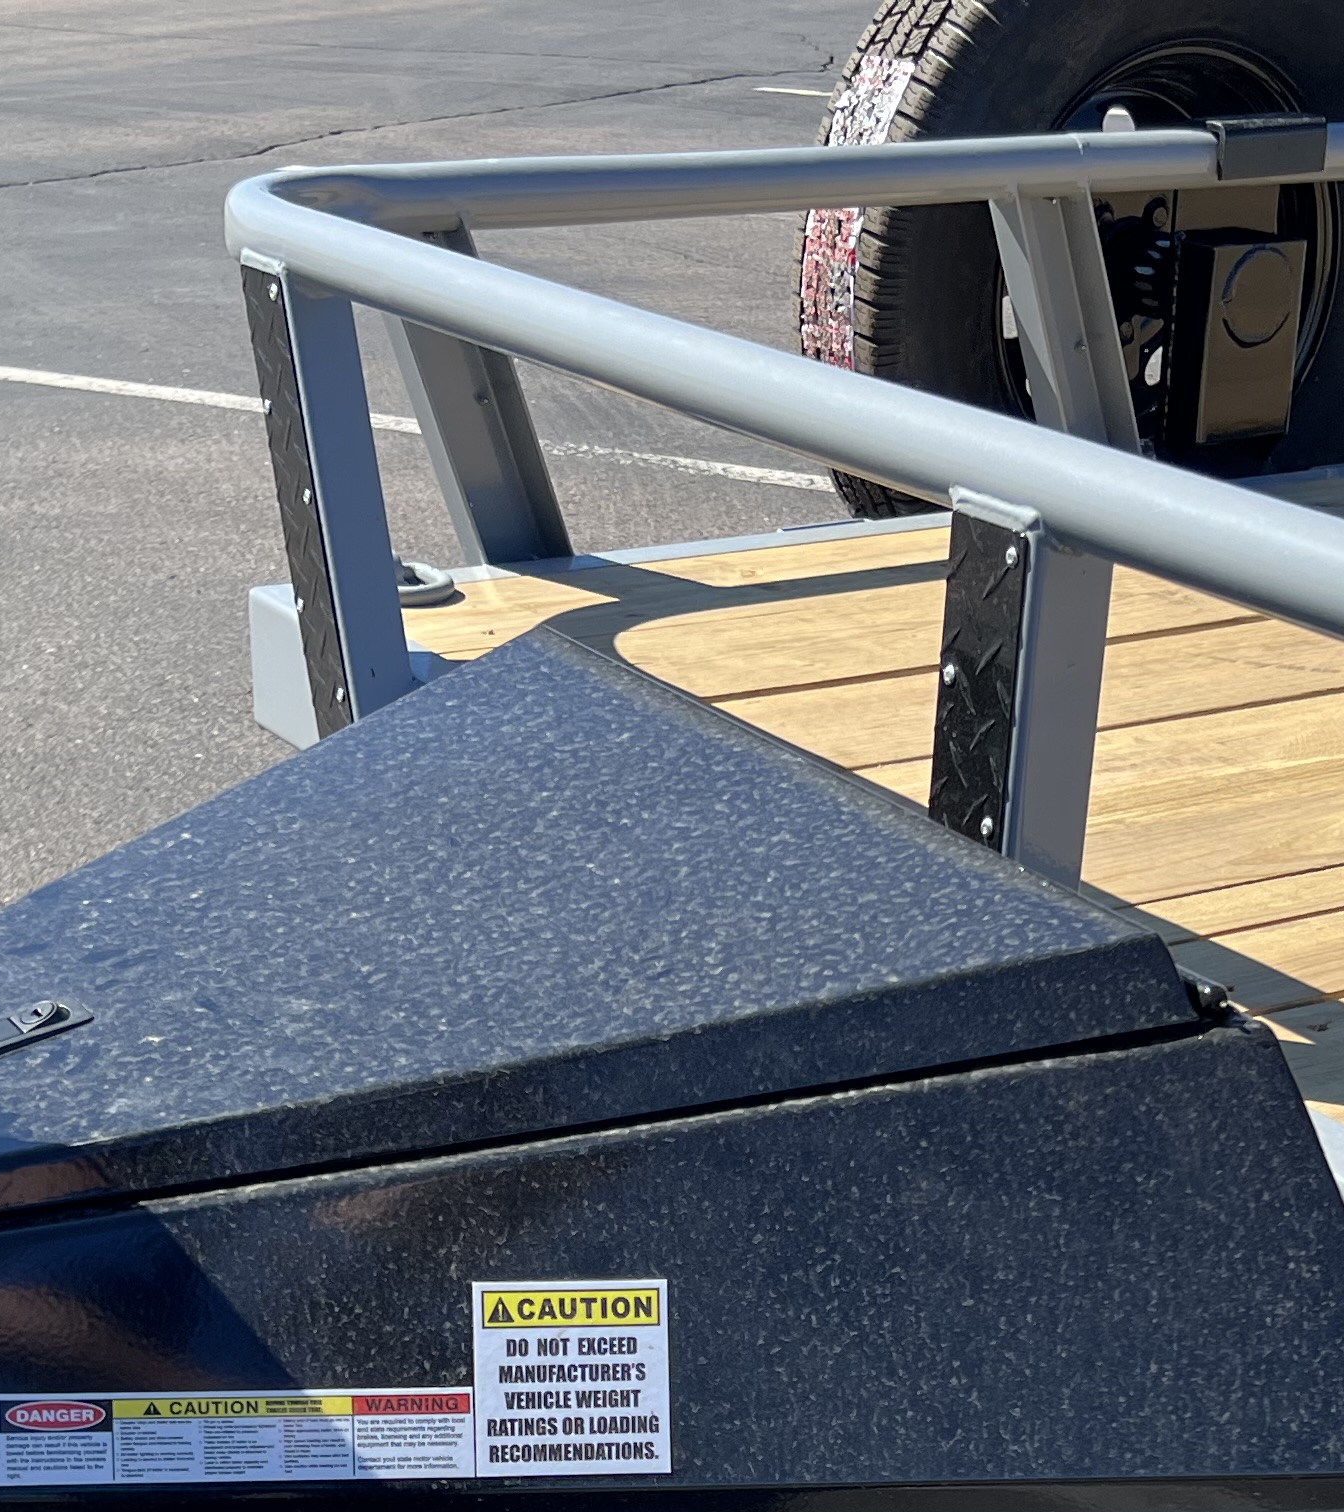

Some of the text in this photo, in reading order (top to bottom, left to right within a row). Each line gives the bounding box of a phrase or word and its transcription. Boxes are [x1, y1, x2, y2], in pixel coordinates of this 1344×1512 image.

[517, 1296, 653, 1320] CAUTION
[506, 1337, 638, 1357] DO NOT EXCEED
[499, 1362, 646, 1384] MANUFACTURER'S
[169, 1400, 259, 1415] CAUTION
[365, 1397, 459, 1412] WARNING
[504, 1390, 641, 1410] VEHICLE WEIGHT
[16, 1409, 94, 1422] DANGER
[487, 1415, 660, 1437] RATINGS OR LOADING
[489, 1442, 659, 1463] RECOMMENDATIONS.
